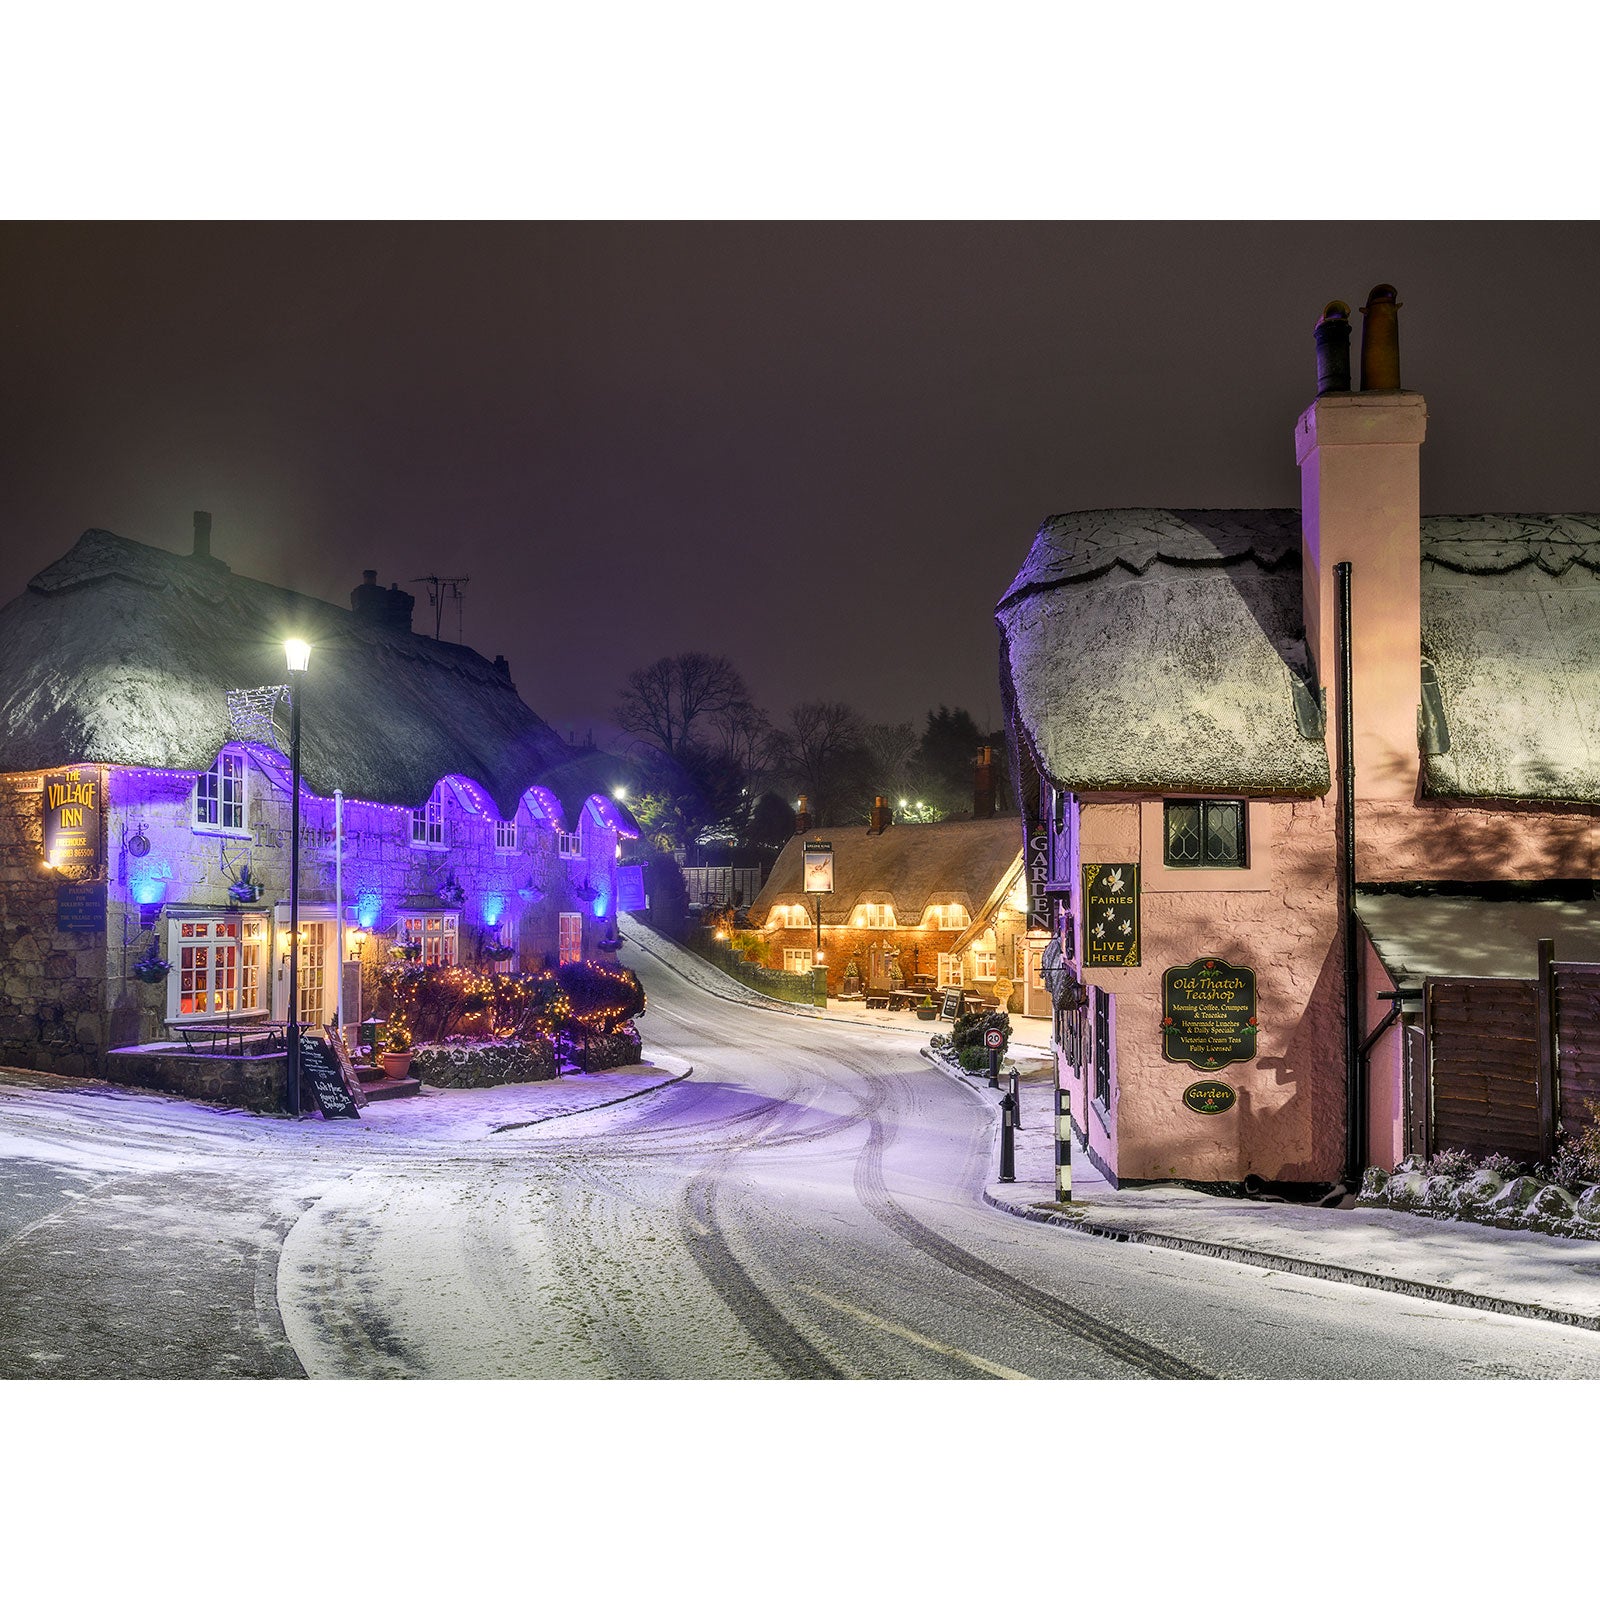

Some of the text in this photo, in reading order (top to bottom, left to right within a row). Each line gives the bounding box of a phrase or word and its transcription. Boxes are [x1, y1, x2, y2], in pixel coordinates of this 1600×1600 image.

[65, 770, 80, 781] THE
[48, 783, 96, 810] VILLAGE
[61, 808, 83, 828] INN
[254, 822, 283, 848] The
[56, 838, 87, 846] FREEHOUSE
[1030, 836, 1051, 928] GARDEN
[1091, 896, 1134, 904] FAIRIES
[1093, 941, 1125, 951] LIVE
[1092, 954, 1122, 962] HERE
[1173, 978, 1246, 989] Old Thatch
[1185, 989, 1235, 1003] Teashop
[1221, 1004, 1249, 1012] Crumpets
[988, 1034, 1000, 1042] 20
[1190, 1045, 1205, 1053] Fully
[1190, 1088, 1231, 1098] Garden
